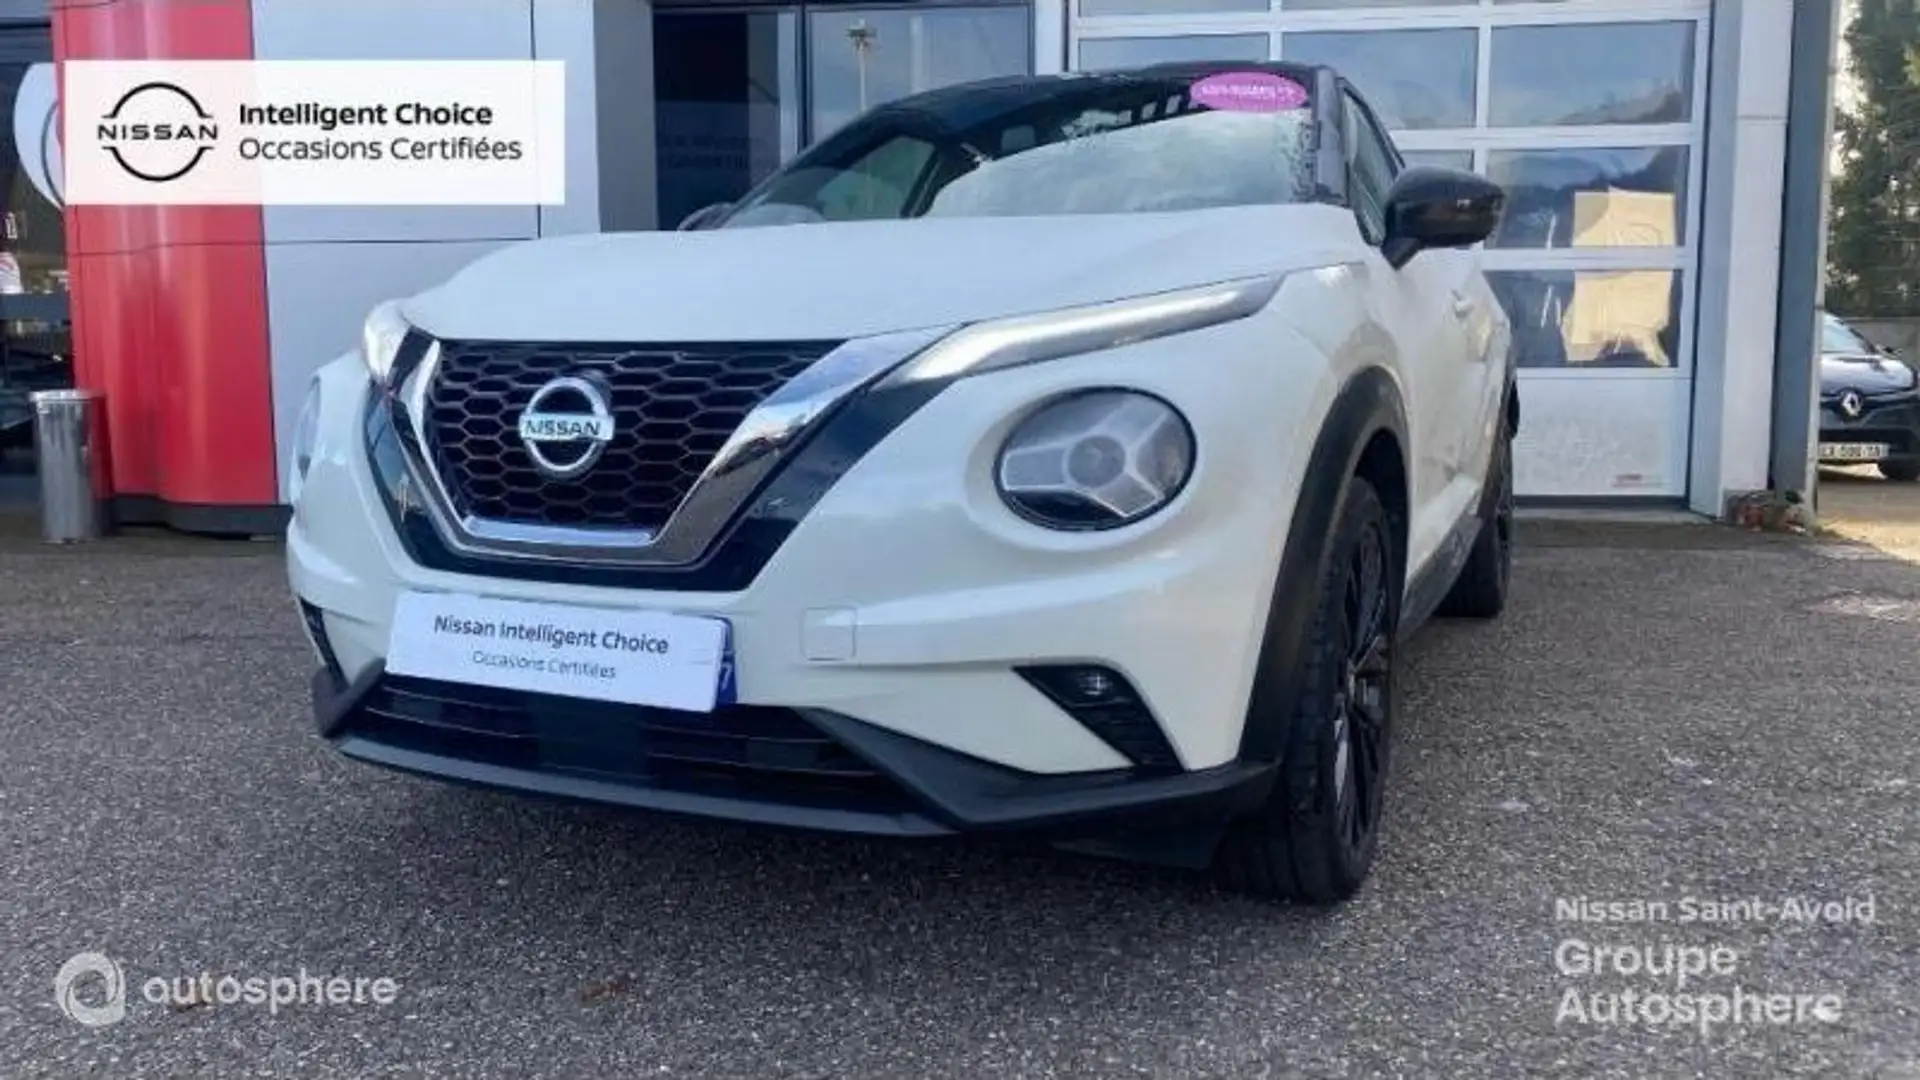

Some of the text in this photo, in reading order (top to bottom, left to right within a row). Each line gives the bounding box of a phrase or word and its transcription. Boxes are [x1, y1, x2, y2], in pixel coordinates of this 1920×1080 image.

[525, 419, 601, 436] NISSAN
[433, 615, 669, 654] Nissan Intelligent Choice
